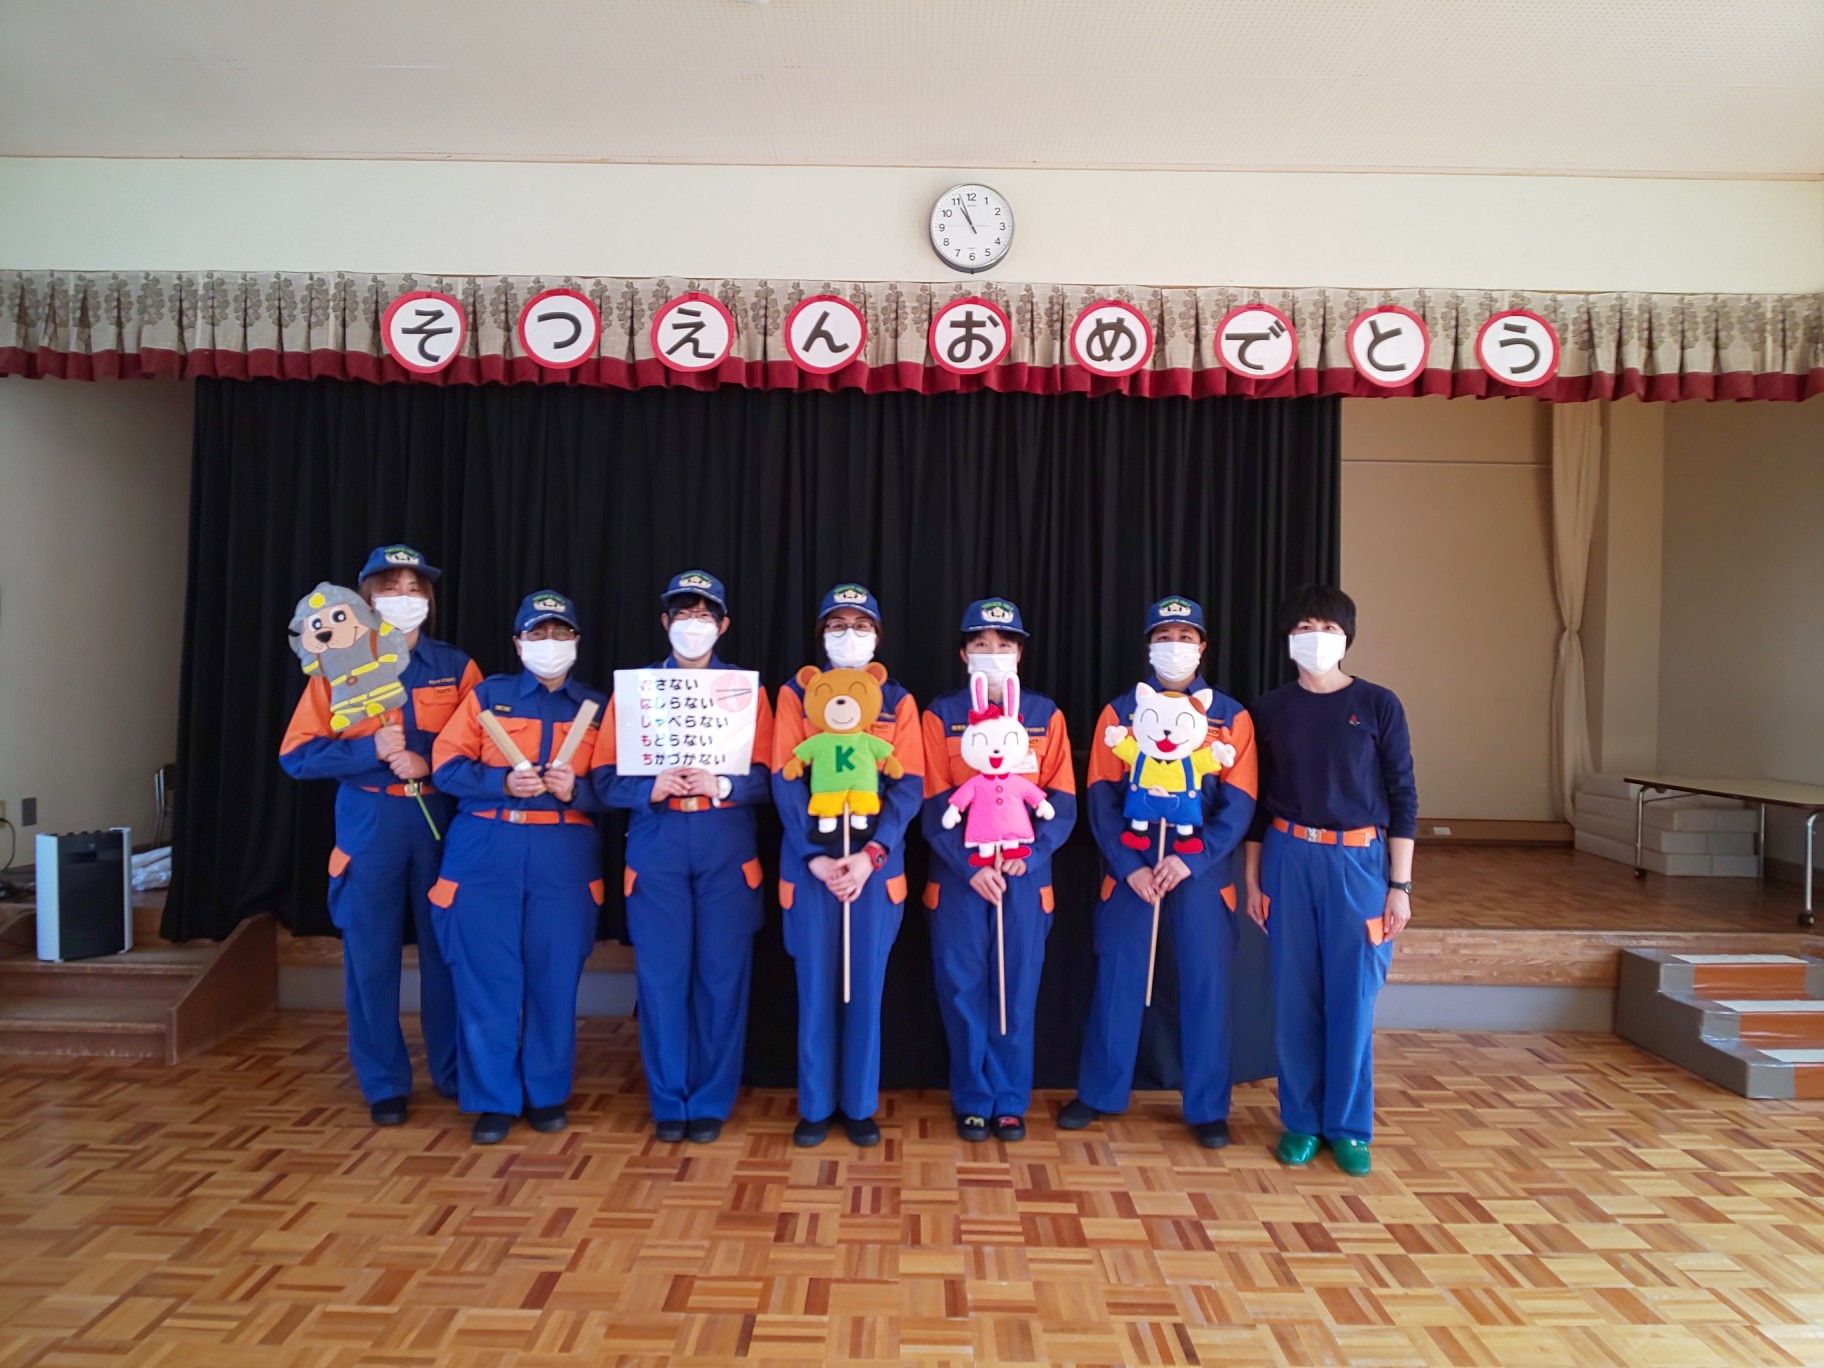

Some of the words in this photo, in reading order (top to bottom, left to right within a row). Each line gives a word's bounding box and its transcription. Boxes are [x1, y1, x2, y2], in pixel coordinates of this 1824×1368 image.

[951, 197, 961, 206] 11
[966, 192, 977, 202] 12
[983, 196, 989, 205] 1
[942, 209, 953, 218] 10
[994, 207, 1001, 216] 2
[938, 223, 946, 232] 9
[999, 222, 1006, 231] 3
[943, 237, 950, 247] 8
[994, 237, 1001, 245] 4
[954, 248, 961, 257] 7
[969, 252, 976, 261] 6
[984, 248, 991, 257] 5
[836, 746, 855, 772] K
